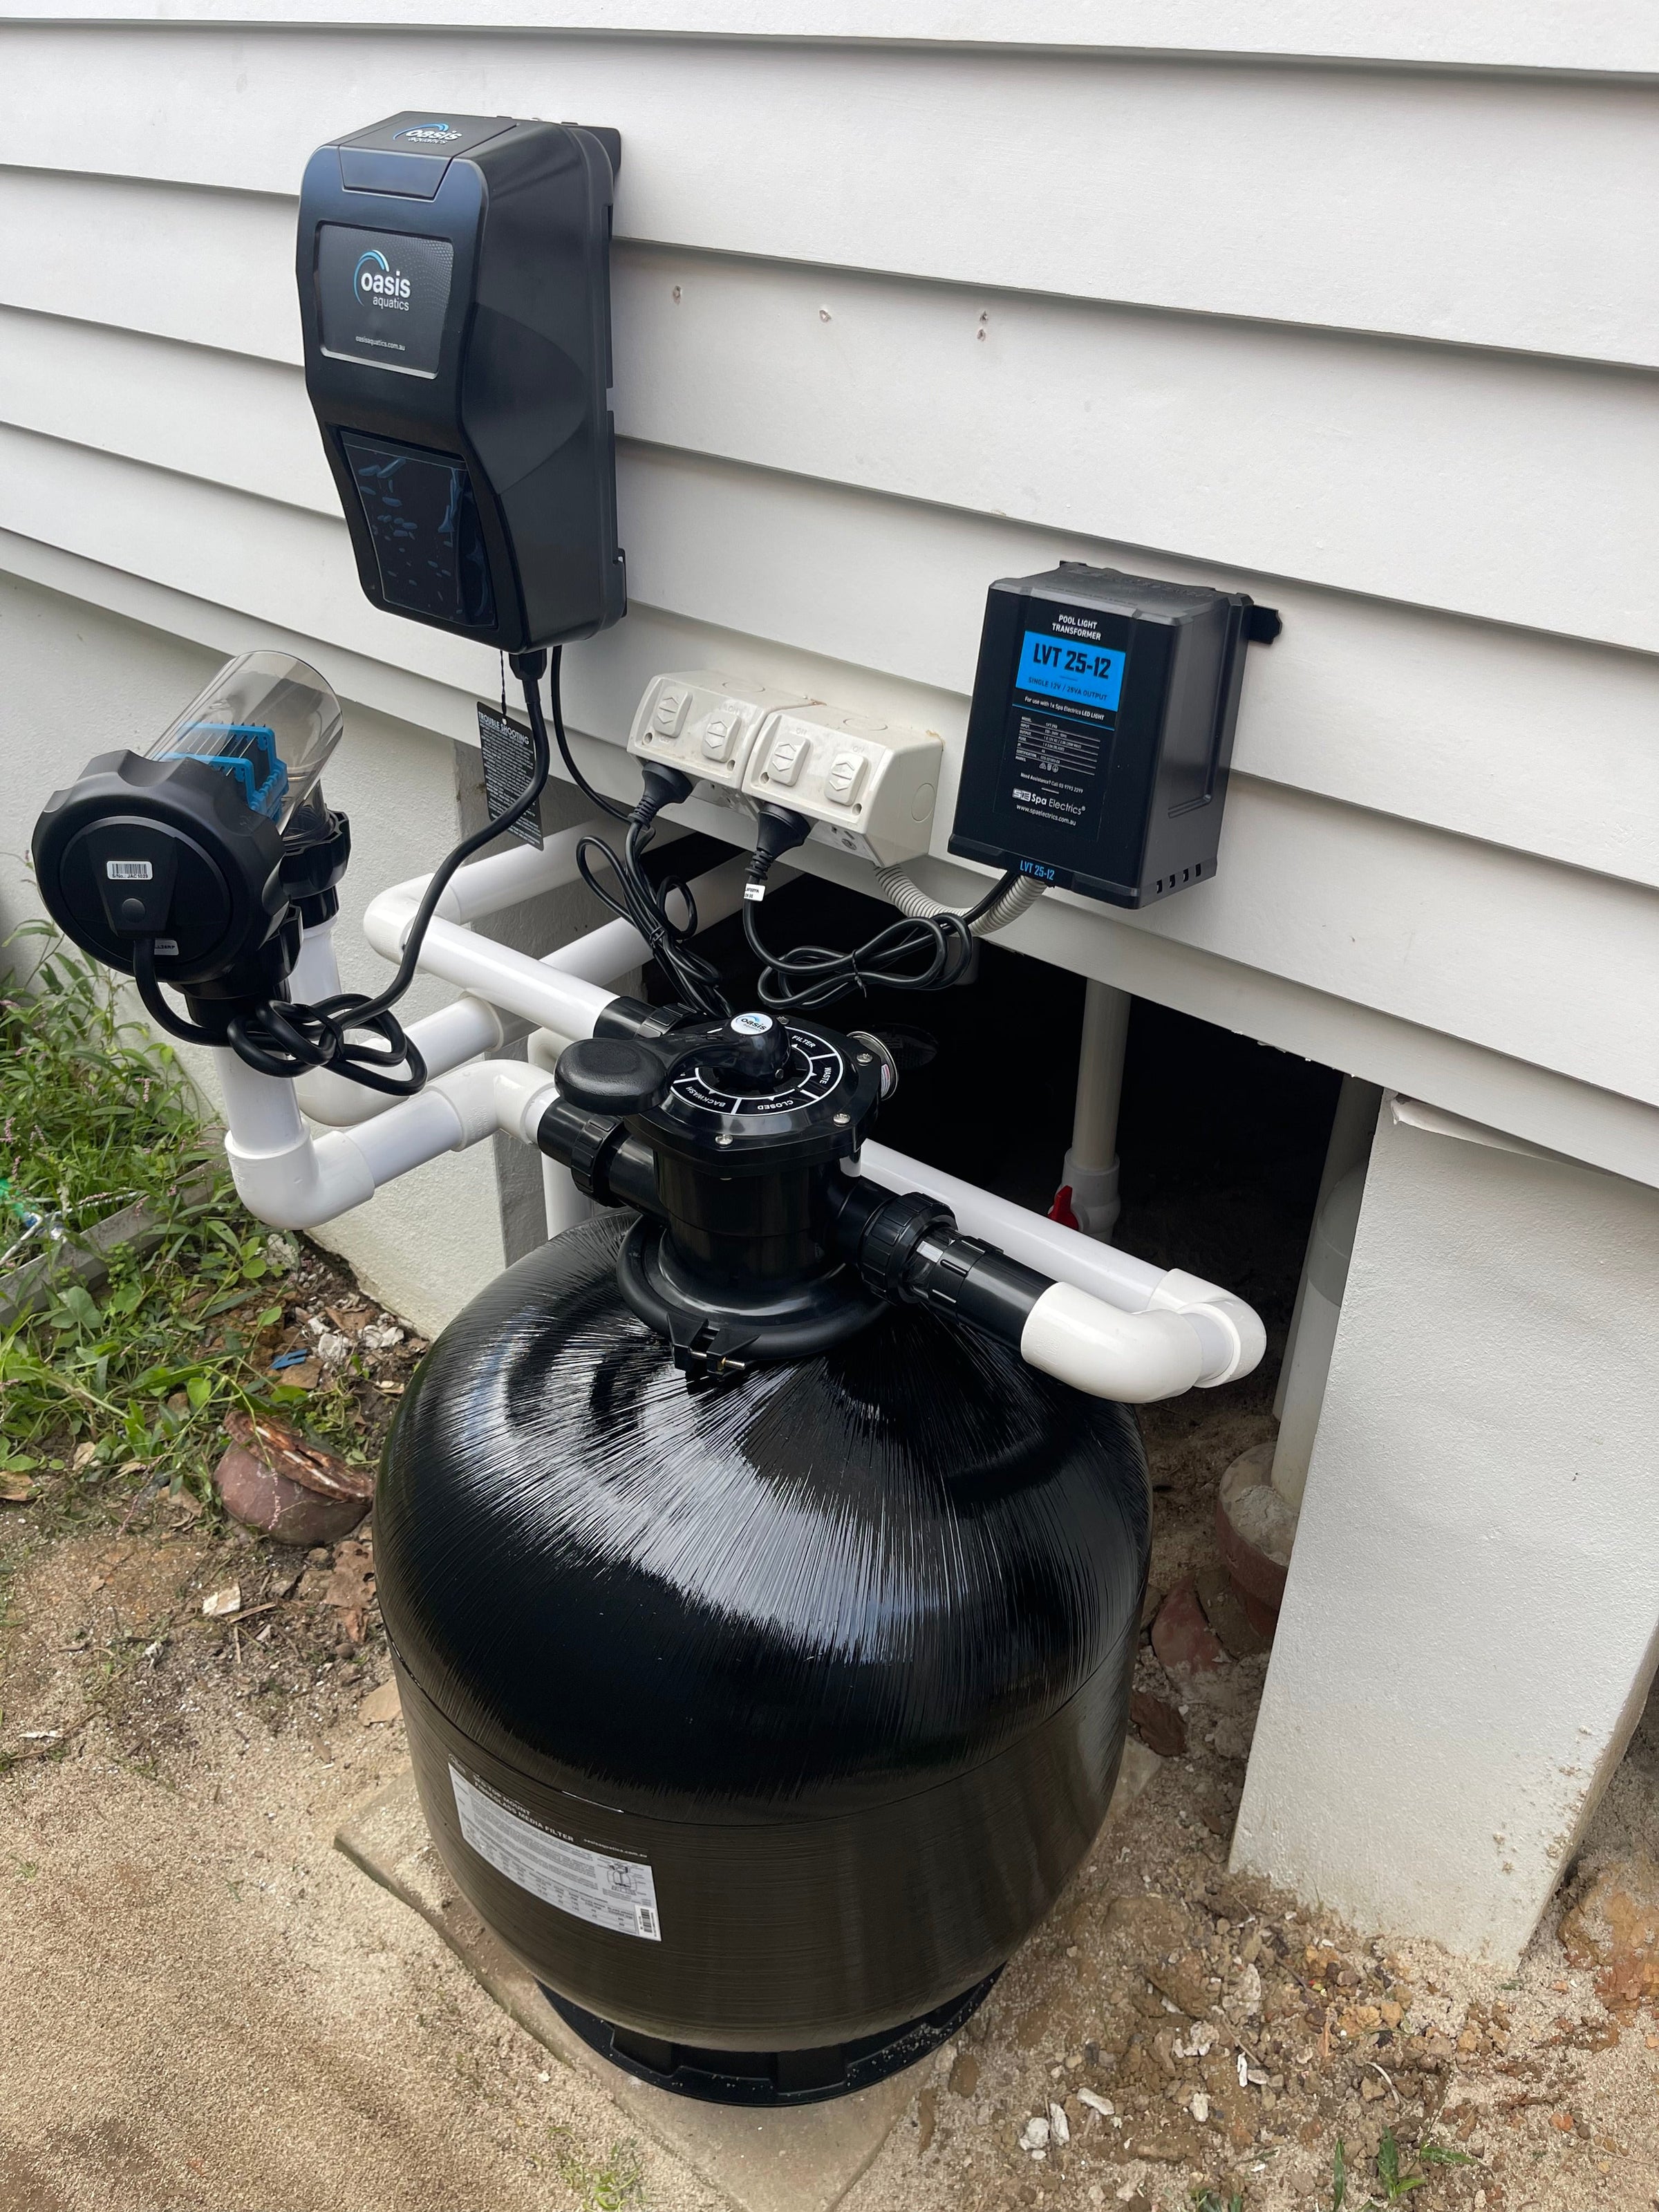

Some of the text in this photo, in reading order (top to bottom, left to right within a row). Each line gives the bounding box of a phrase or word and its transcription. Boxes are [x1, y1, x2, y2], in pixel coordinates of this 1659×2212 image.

[406, 129, 462, 140] oasis
[361, 270, 411, 298] oasis
[373, 296, 409, 311] aquatics
[355, 335, 406, 351] oasisaquatics.com.au
[1058, 614, 1098, 630] POOL LIGHT
[1051, 622, 1102, 641] TRANSFORMER
[1033, 642, 1112, 679] LVT 25-12
[1028, 676, 1049, 688] SINGLE
[1050, 681, 1061, 691] 12V
[1067, 685, 1082, 695] 25VA
[1083, 689, 1107, 701] OUTPUT
[1063, 706, 1082, 715] Electrics
[1091, 712, 1105, 721] LIGHT
[478, 711, 529, 745] TROUBLE SHOOTING
[1030, 775, 1051, 785] Assistance?
[1031, 793, 1047, 805] Spa
[1016, 804, 1077, 826] www.spaelectrics.com.au
[1020, 860, 1055, 881] LVT 25-12
[741, 1018, 767, 1030] oasis
[791, 1035, 816, 1048] FILTER
[819, 1067, 832, 1085] WASTE
[686, 1086, 727, 1107] BACKWASH
[757, 1099, 794, 1110] CLOSED
[503, 1797, 530, 1816] MOUNT
[518, 1812, 543, 1828] MEDIA
[545, 1825, 574, 1842] FILTER
